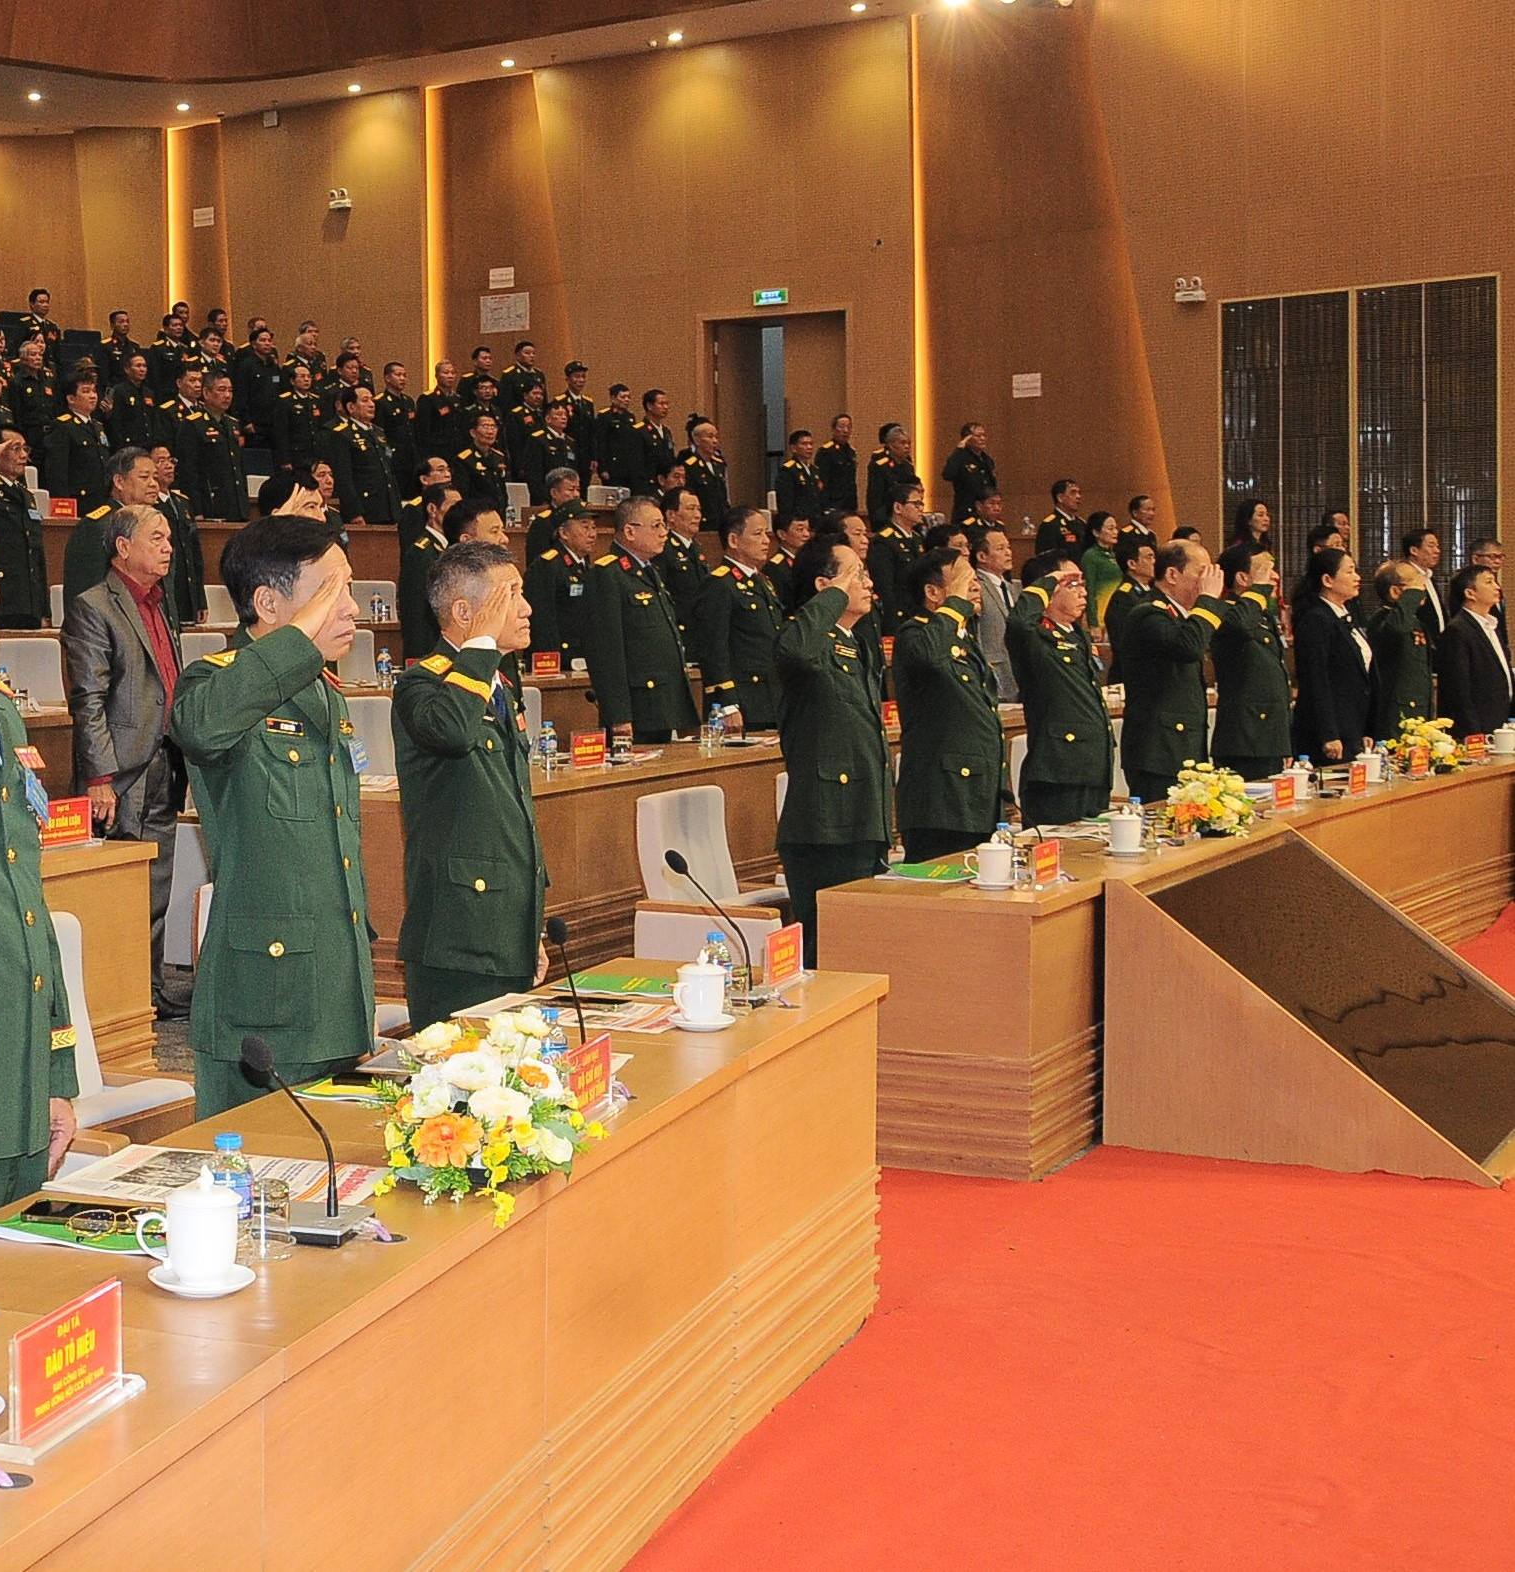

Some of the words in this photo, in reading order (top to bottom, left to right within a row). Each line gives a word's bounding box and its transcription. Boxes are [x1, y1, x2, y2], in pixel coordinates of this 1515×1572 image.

[56, 1321, 70, 1338] ĐẠI
[70, 1310, 81, 1328] TÁ
[45, 1347, 63, 1379] ĐÀO
